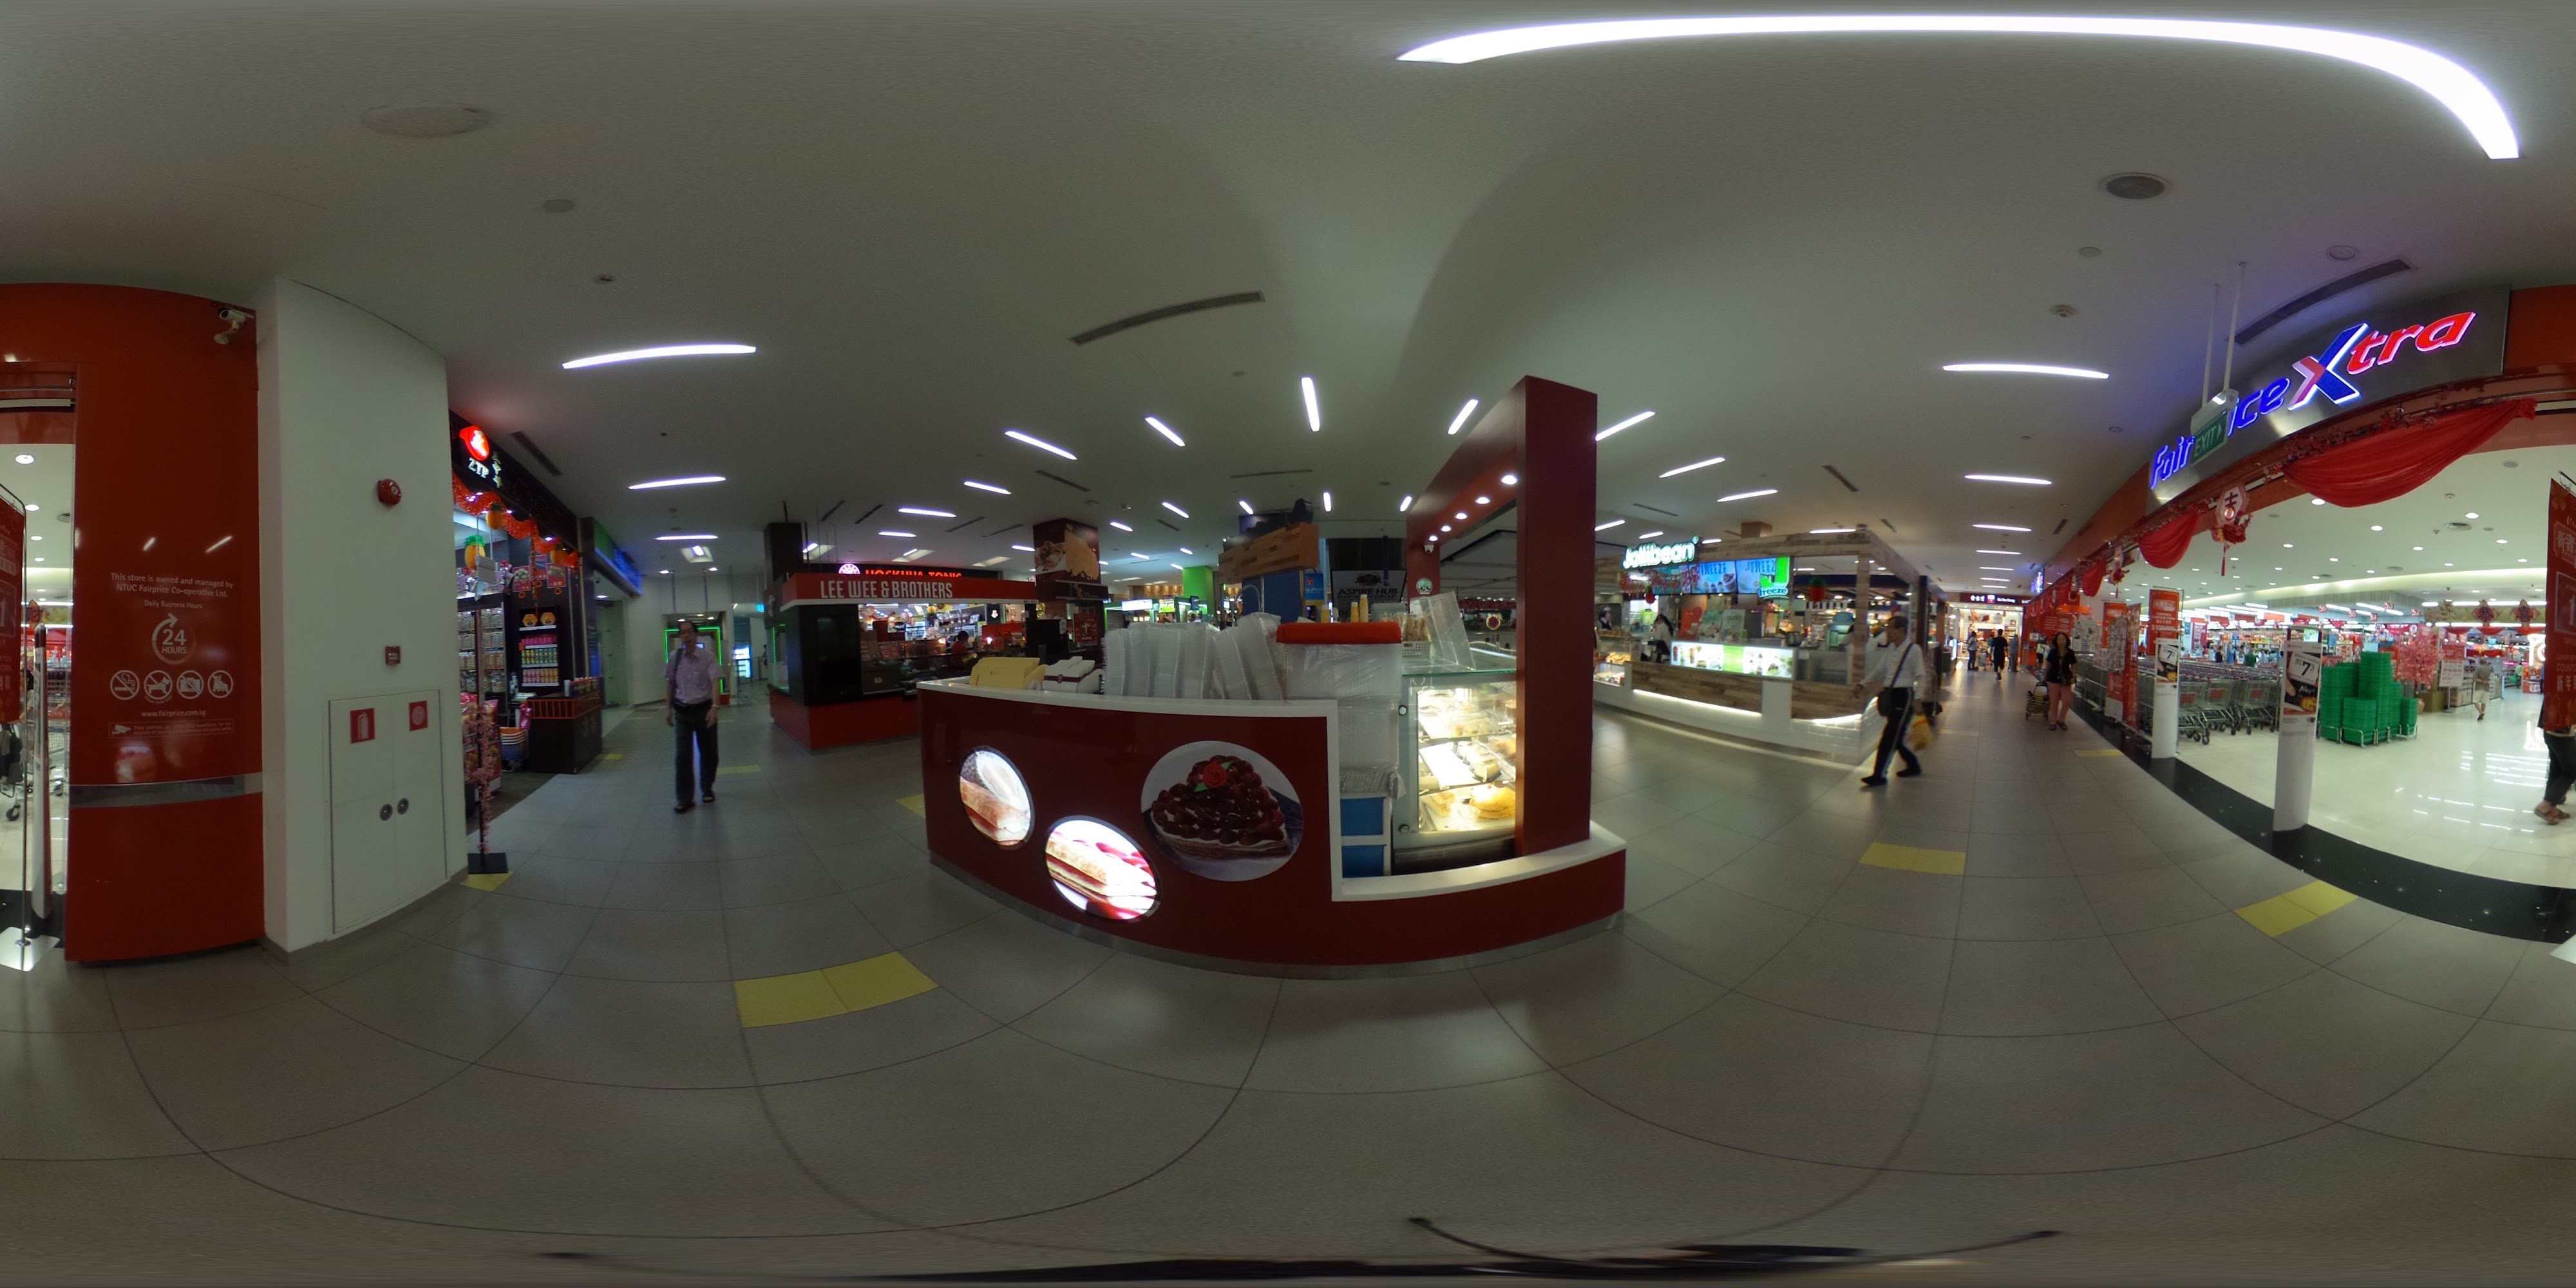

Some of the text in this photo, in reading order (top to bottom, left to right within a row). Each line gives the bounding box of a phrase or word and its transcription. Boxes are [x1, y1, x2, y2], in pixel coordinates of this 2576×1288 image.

[2150, 311, 2477, 491] Fairice Xtra
[2194, 425, 2217, 458] EXIT
[468, 457, 489, 478] ZTP
[1623, 542, 1695, 569] Jollibean
[117, 583, 137, 592] NTUC
[139, 585, 169, 594] Fairprice
[171, 587, 214, 596] Co-operative
[194, 580, 223, 589] managed
[820, 581, 953, 599] LEE WEE & BROTHERS
[1759, 587, 1787, 596] freeze
[162, 629, 187, 645] 24
[162, 646, 187, 654] HOURS
